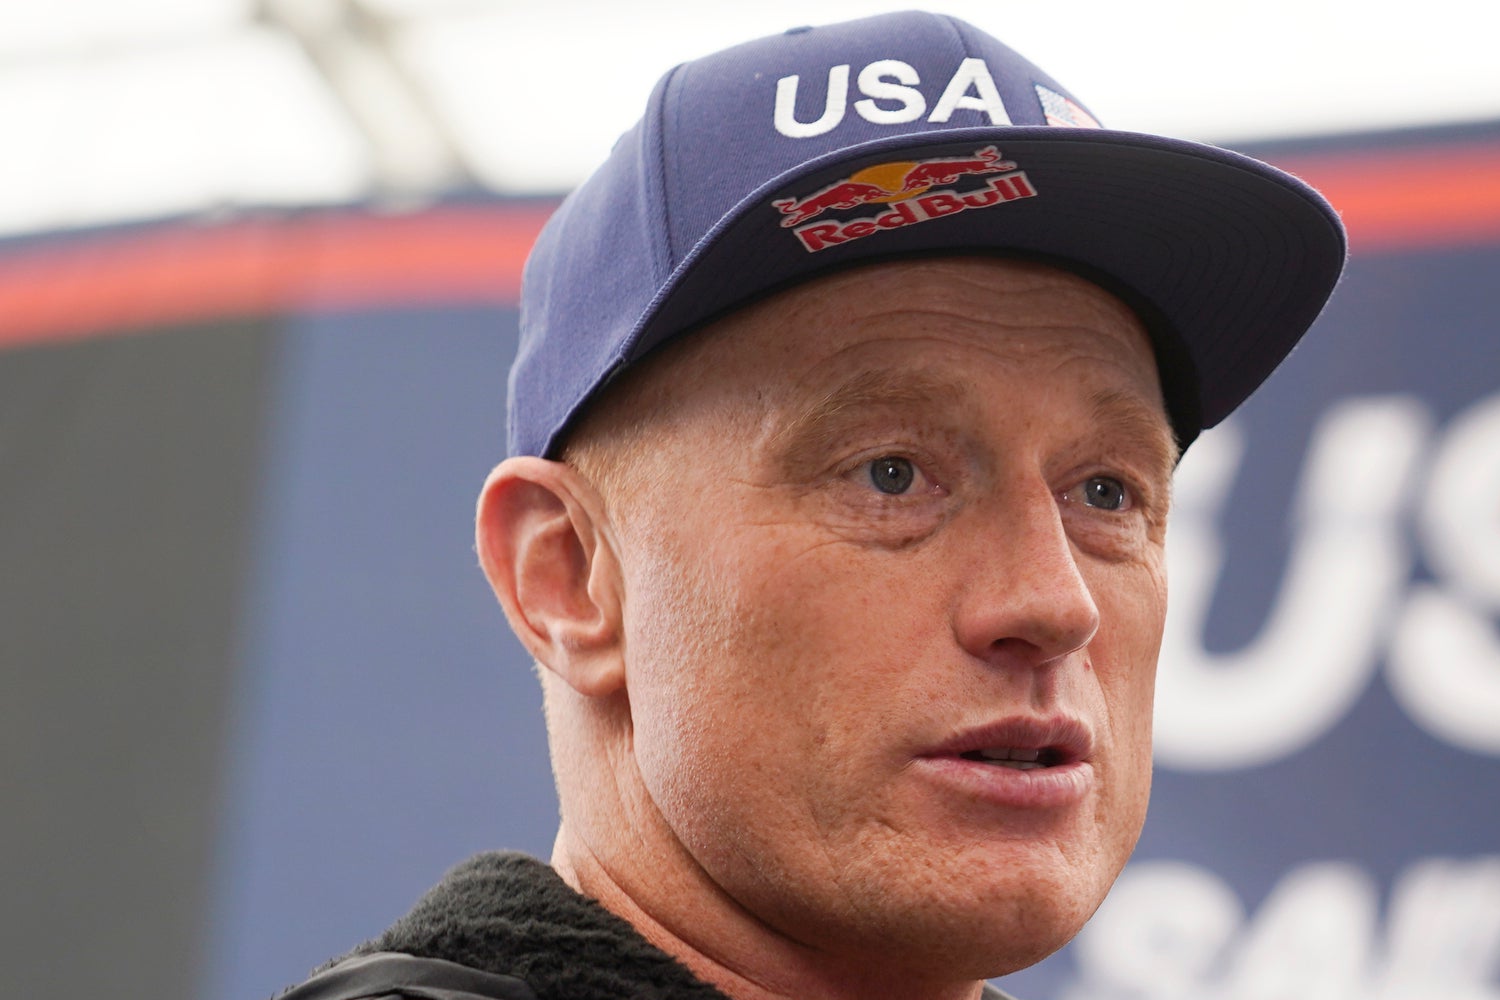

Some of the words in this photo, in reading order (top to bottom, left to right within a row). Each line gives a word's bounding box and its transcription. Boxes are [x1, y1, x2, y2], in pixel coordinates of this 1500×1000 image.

[773, 57, 1013, 138] USA
[794, 203, 919, 252] Red
[917, 172, 1036, 220] Bull
